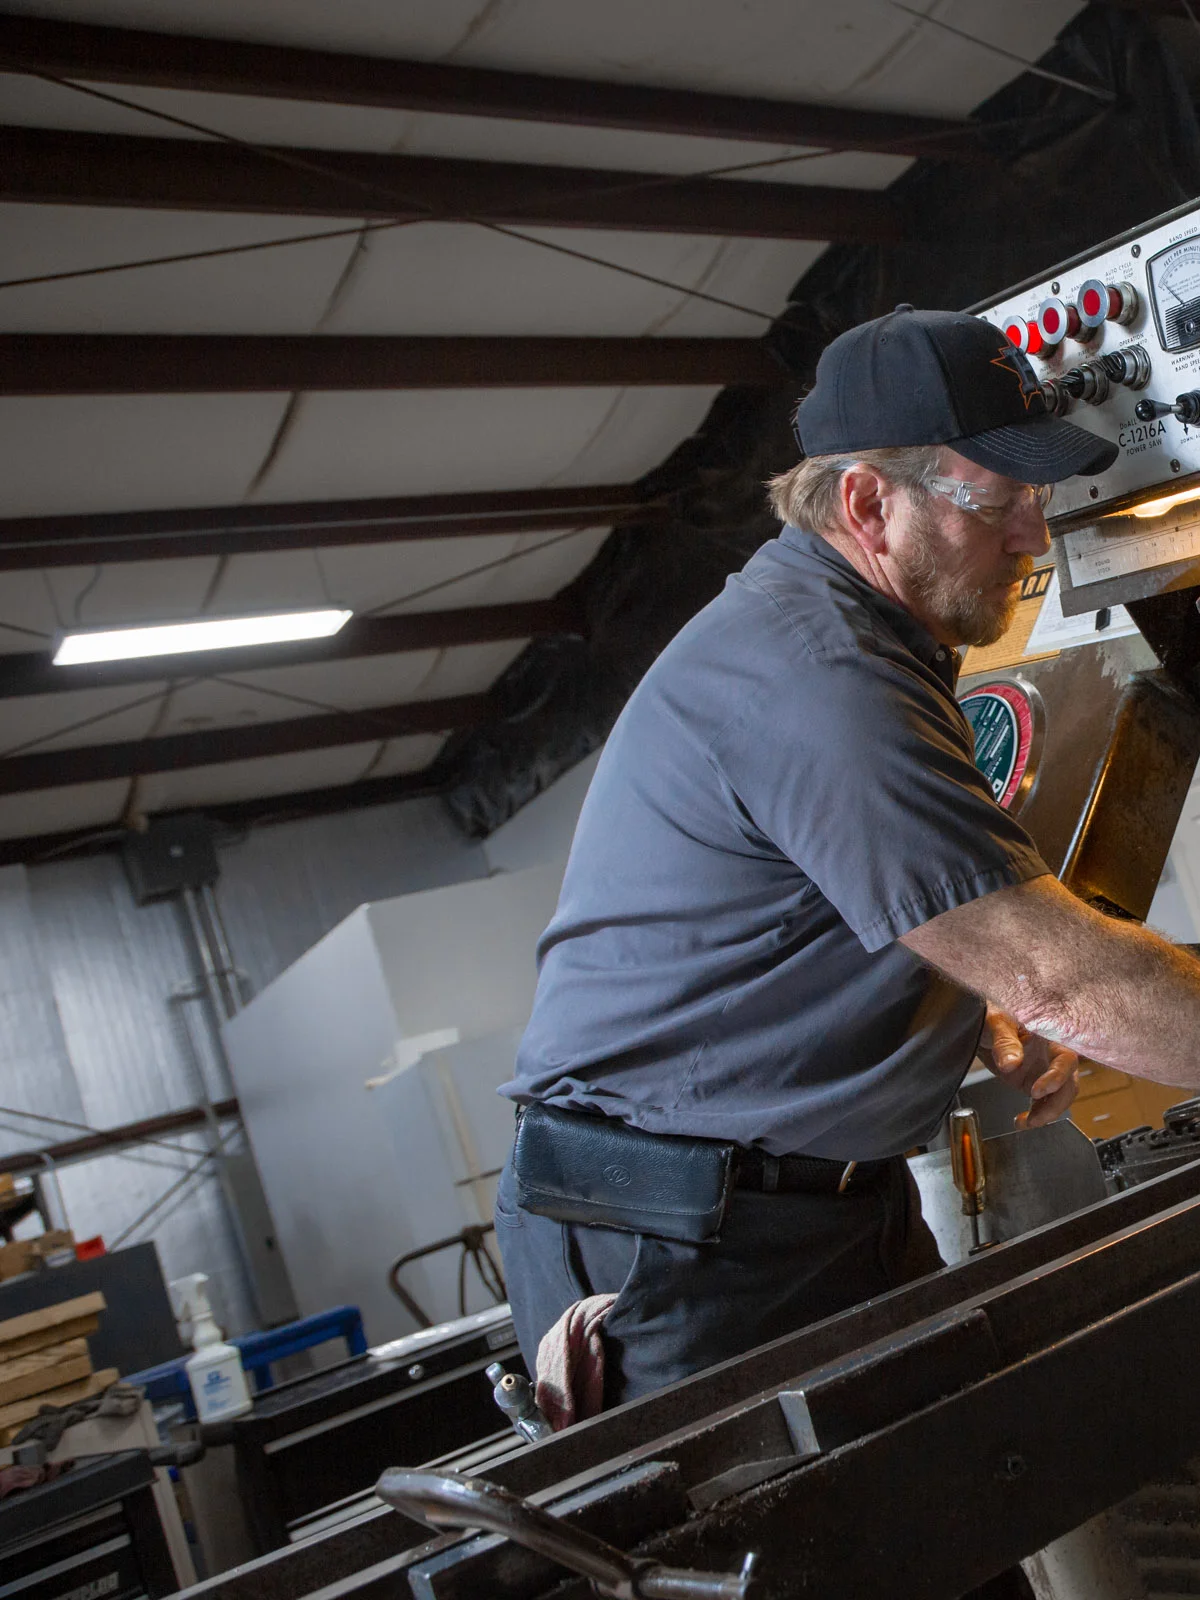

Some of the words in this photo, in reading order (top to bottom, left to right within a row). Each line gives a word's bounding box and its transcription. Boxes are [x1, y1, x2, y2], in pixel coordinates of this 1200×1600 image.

[1169, 233, 1182, 244] BAND
[1184, 226, 1198, 237] SPEED
[1173, 249, 1182, 257] PER
[1105, 267, 1117, 277] AUTO
[1118, 261, 1132, 271] CYCLE
[1119, 333, 1144, 347] OPERATION
[1171, 352, 1194, 366] WARNING
[1175, 362, 1189, 373] BAND
[1119, 418, 1137, 431] DoALL
[1118, 420, 1167, 448] C-1216A
[1126, 444, 1148, 457] POWER
[1149, 437, 1163, 449] SAW
